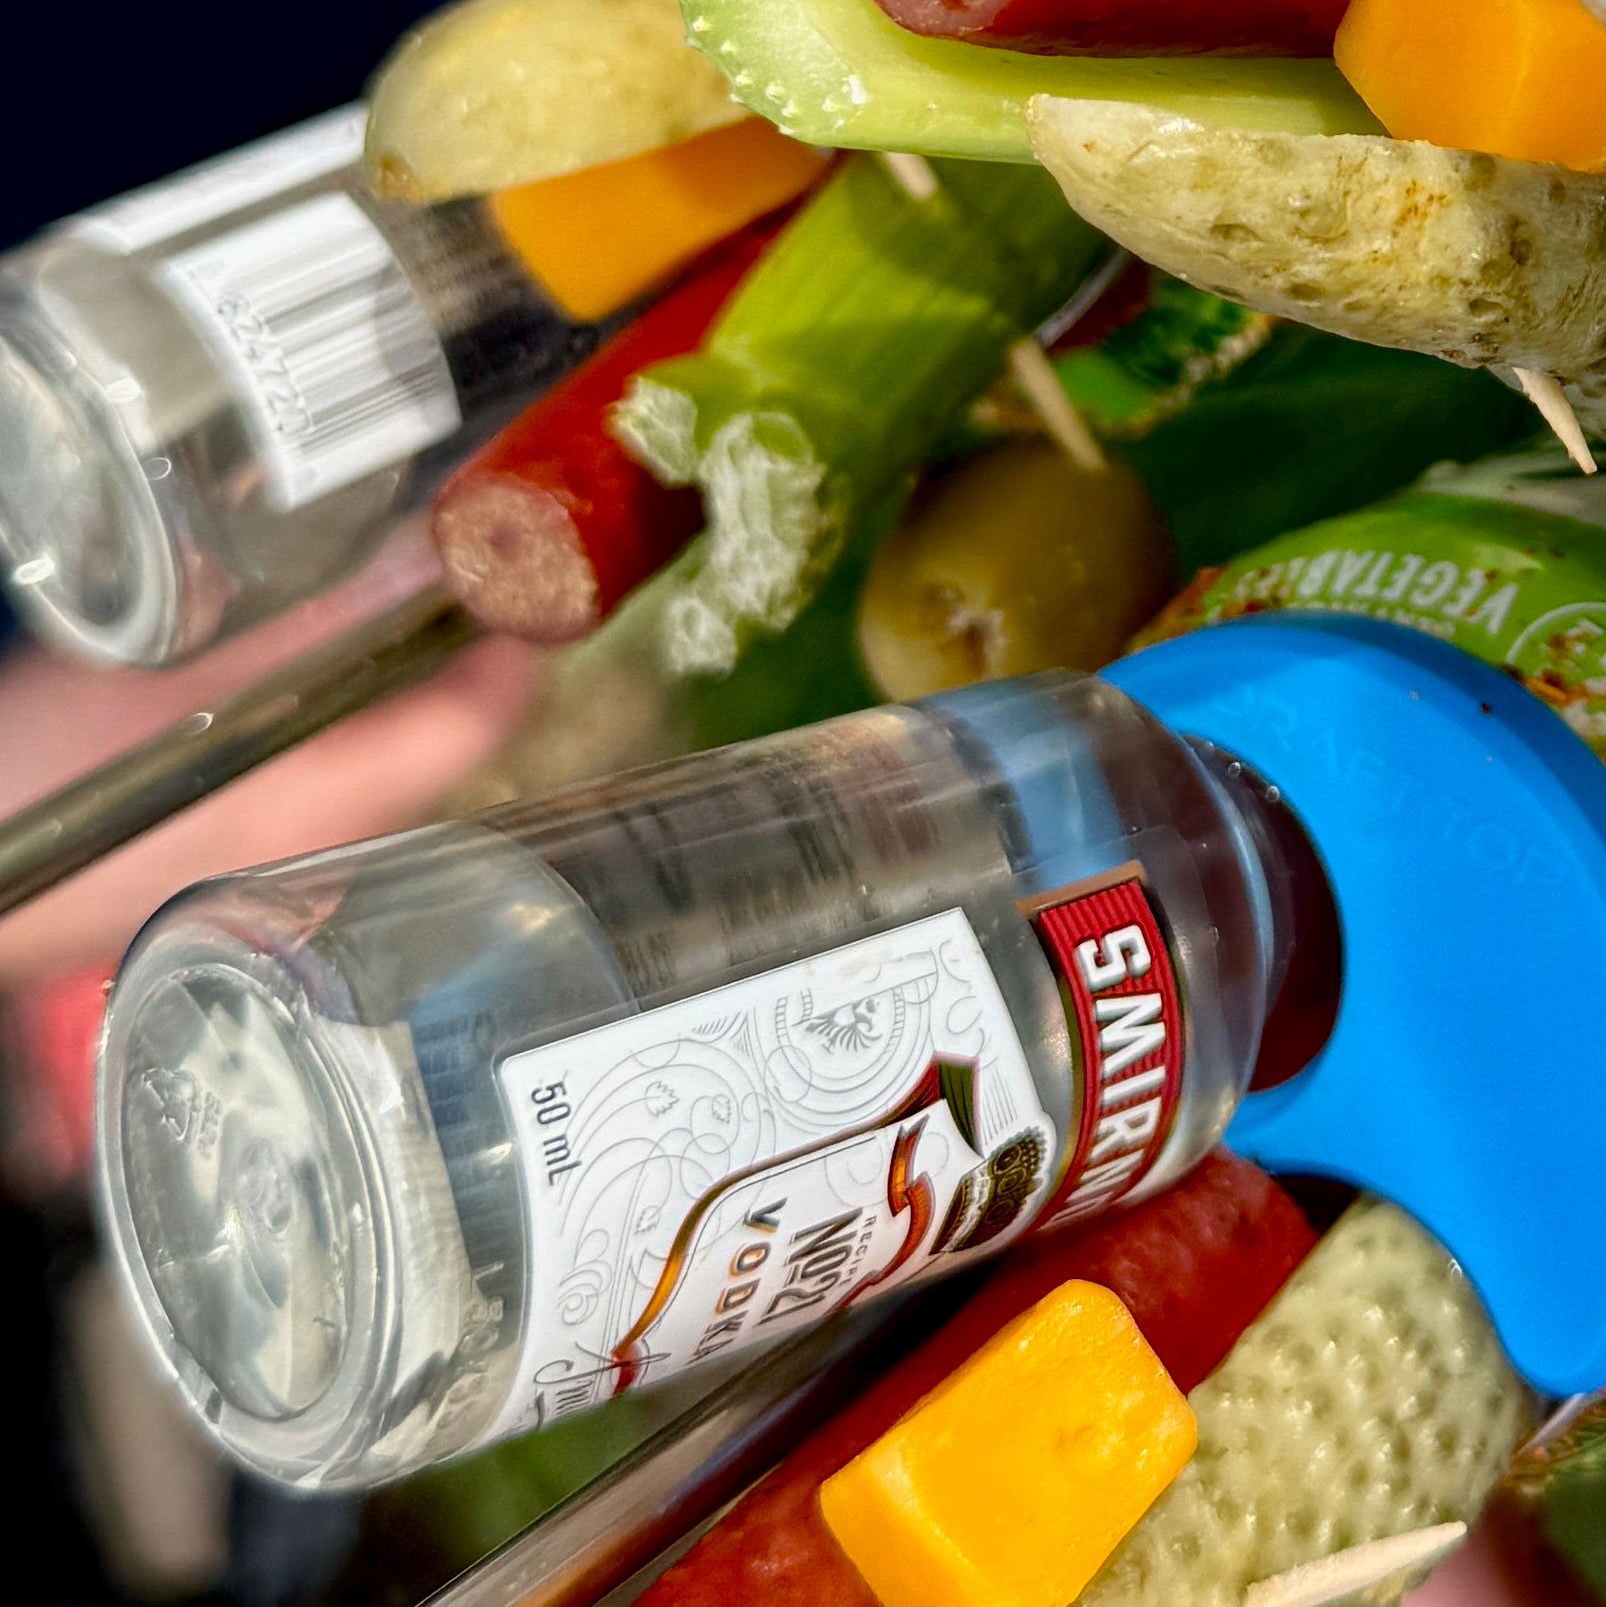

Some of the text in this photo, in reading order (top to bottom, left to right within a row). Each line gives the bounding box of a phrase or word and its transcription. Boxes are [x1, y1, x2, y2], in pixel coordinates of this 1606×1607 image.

[531, 1081, 582, 1187] 50 mL
[684, 1197, 788, 1366] VODKA
